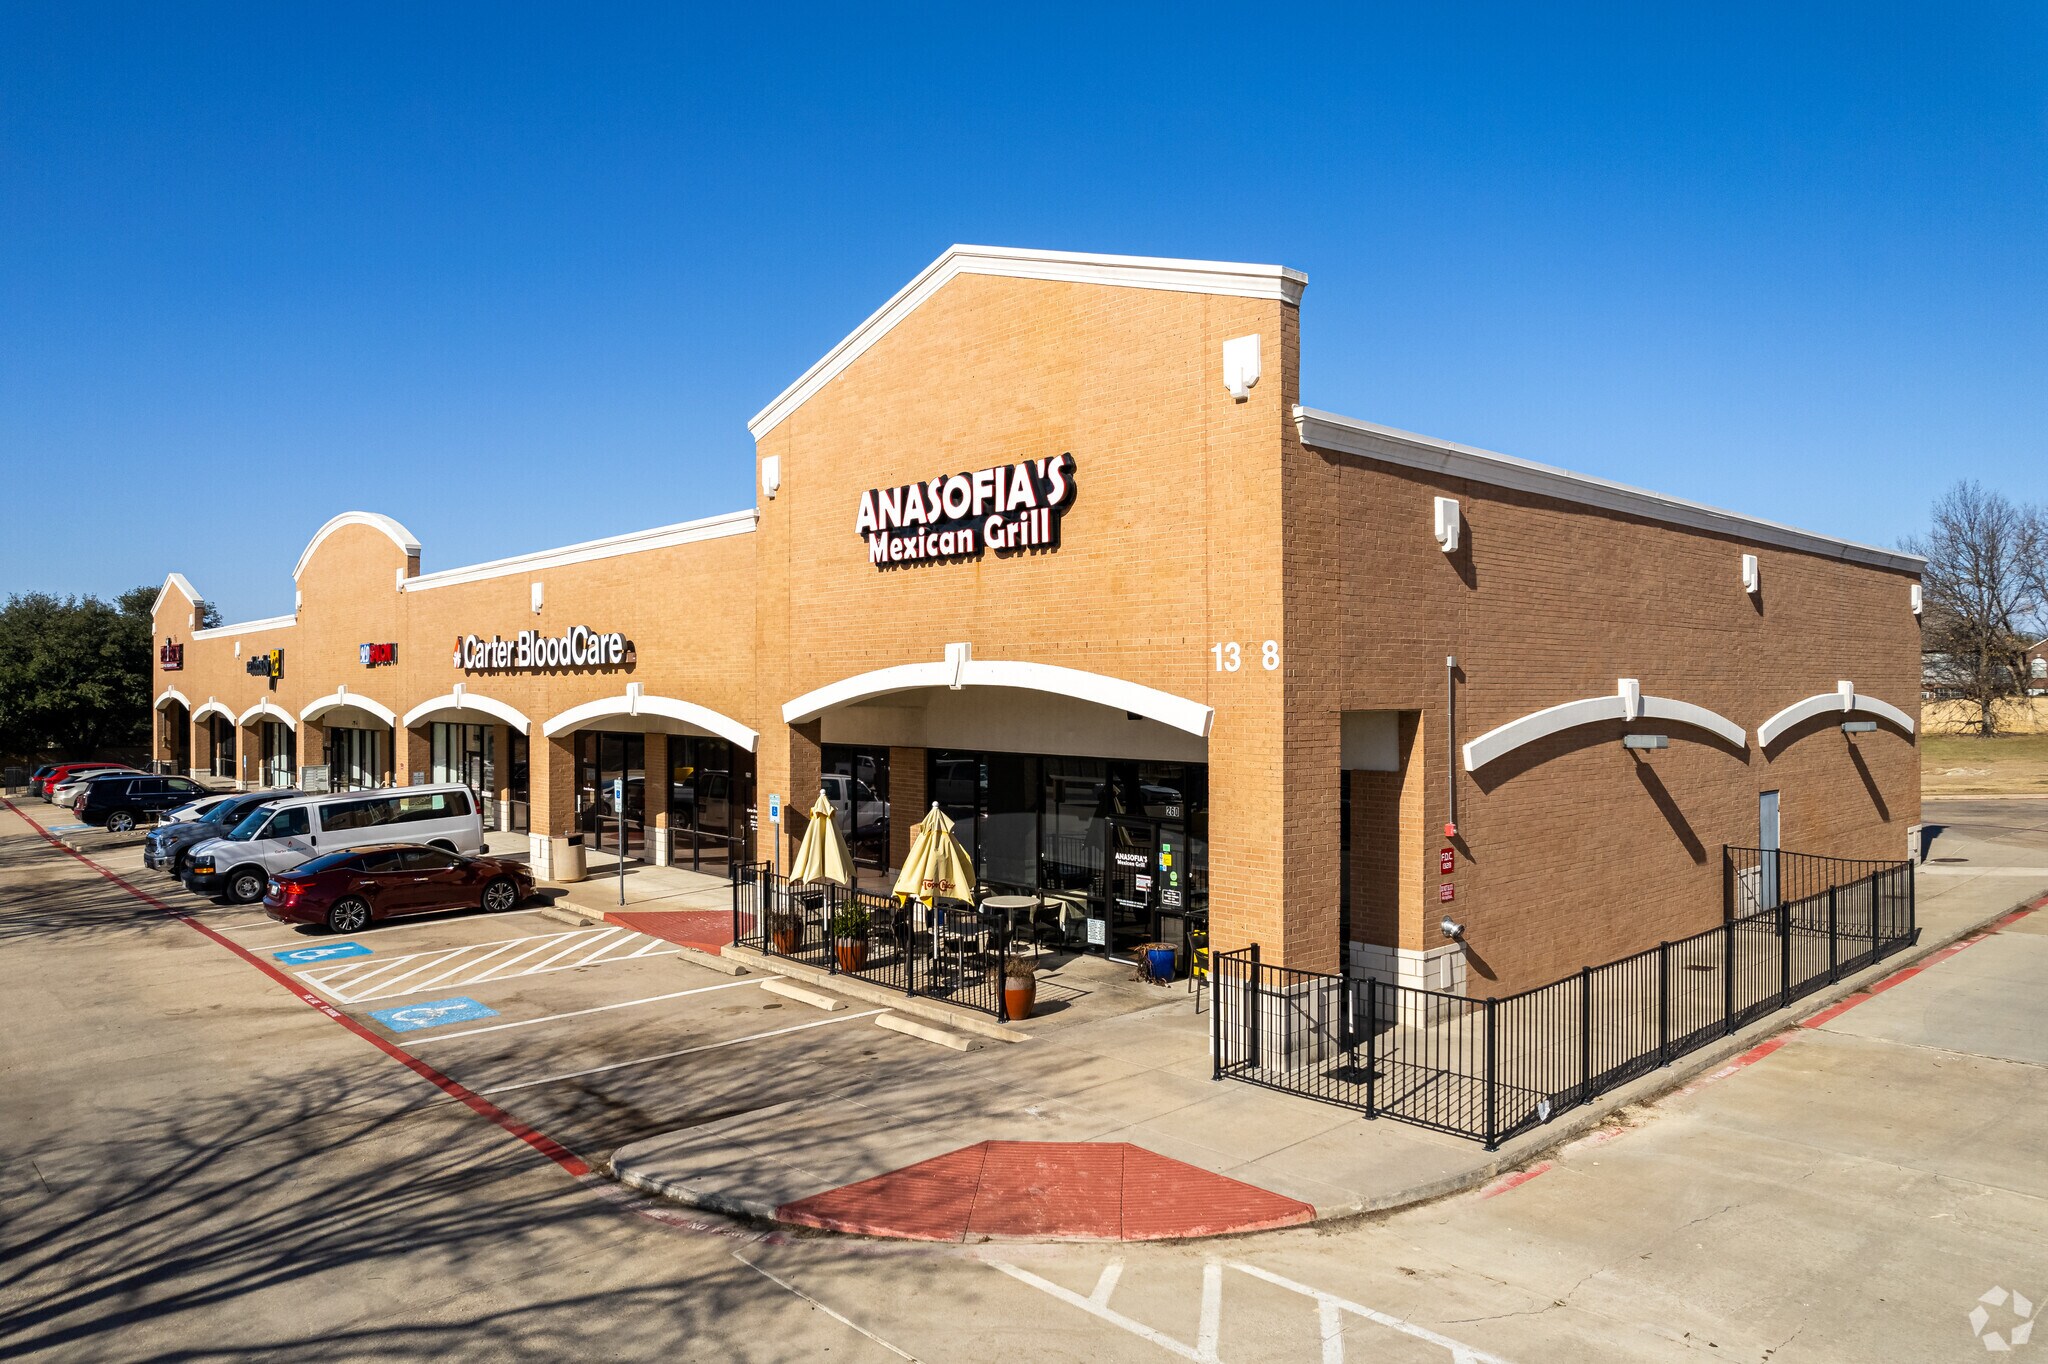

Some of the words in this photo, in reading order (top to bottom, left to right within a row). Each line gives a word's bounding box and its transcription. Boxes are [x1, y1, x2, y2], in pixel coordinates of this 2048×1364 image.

[854, 454, 1069, 534] ANASOFIA'S
[869, 526, 975, 563] Mexican
[983, 507, 1053, 550] Grill
[464, 634, 515, 669] Carter
[518, 624, 625, 668] BloodCare
[1165, 805, 1180, 817] 260
[1115, 852, 1148, 863] ANASOFIA'S
[1117, 859, 1135, 867] Mexican
[939, 878, 956, 892] Chico
